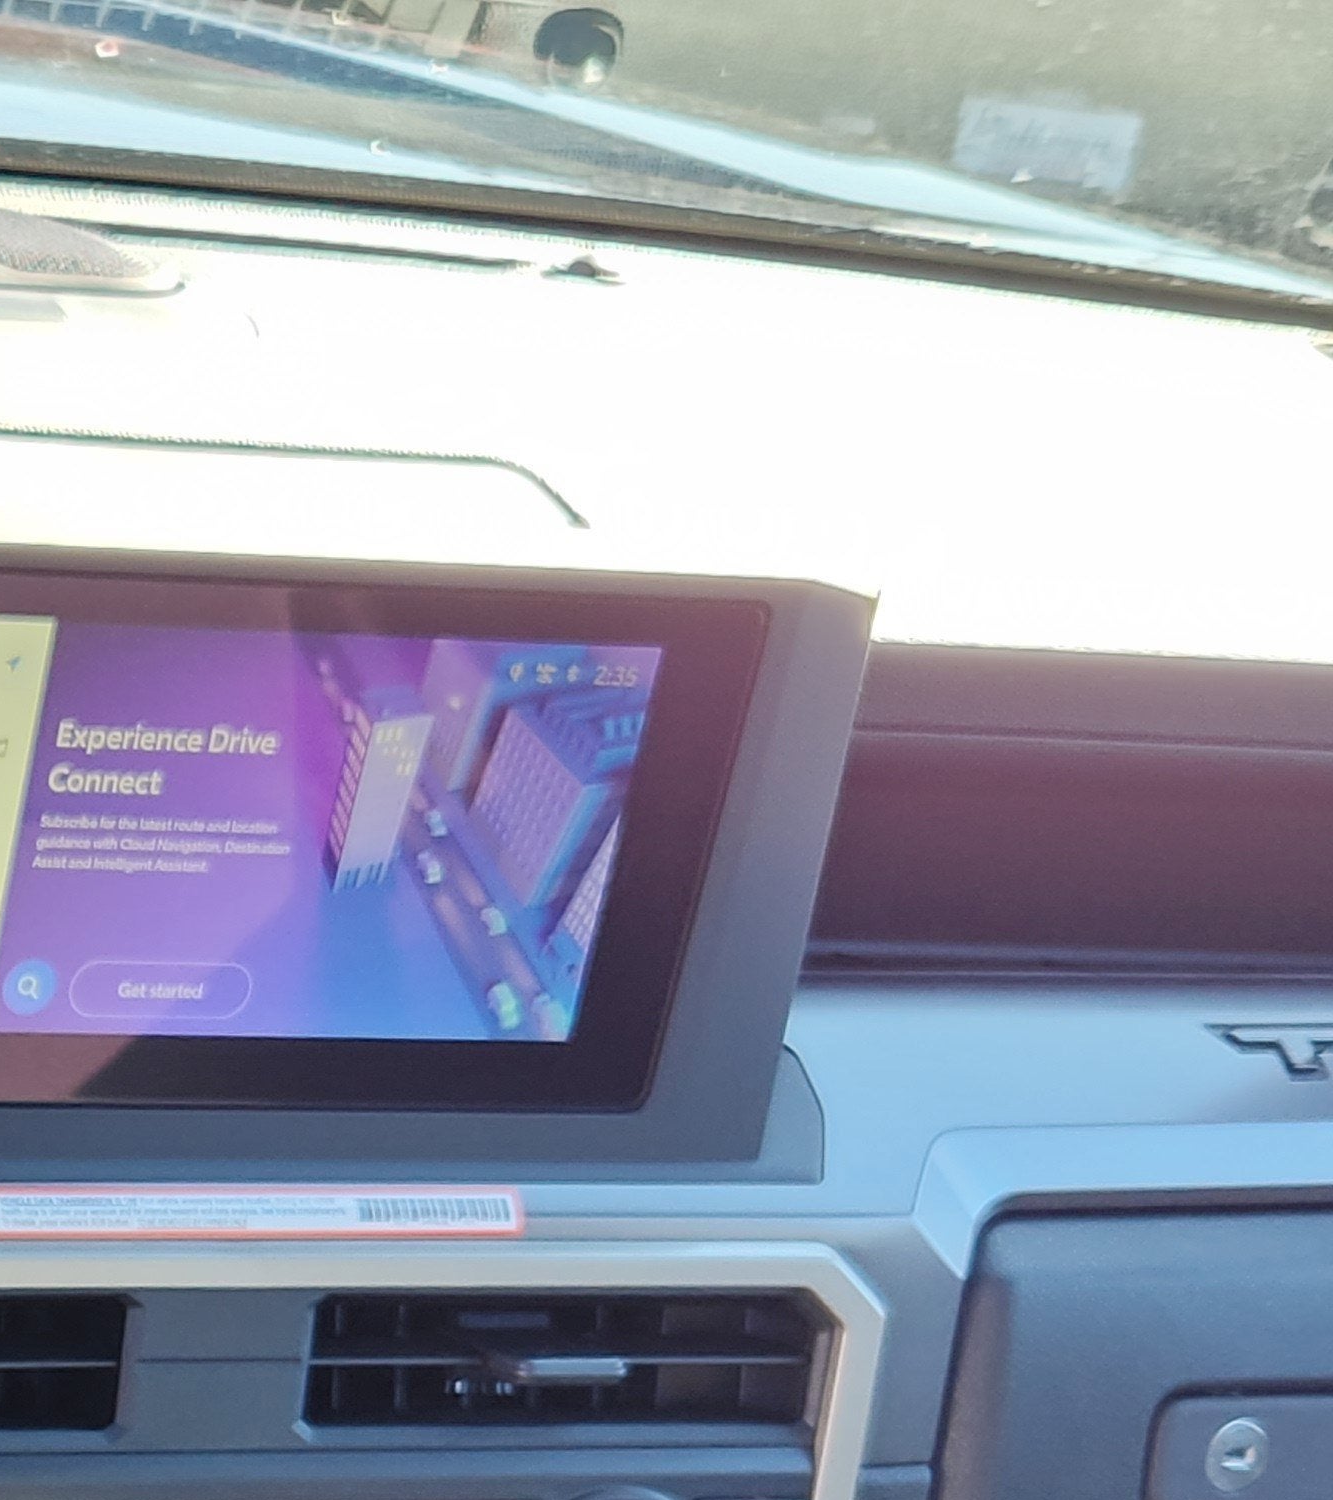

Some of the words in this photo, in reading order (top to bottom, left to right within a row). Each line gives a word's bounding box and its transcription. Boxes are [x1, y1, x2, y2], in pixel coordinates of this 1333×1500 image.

[593, 665, 638, 688] 2:35
[55, 719, 203, 755] Experience
[208, 726, 280, 755] Drive
[48, 765, 163, 795] Connect
[118, 818, 136, 831] the
[140, 819, 172, 832] latest
[174, 821, 204, 833] route
[206, 821, 230, 833] and
[120, 838, 155, 852] Cloud
[32, 857, 67, 870] Assist
[68, 858, 92, 870] and
[118, 981, 146, 999] Get
[149, 981, 203, 1000] started
